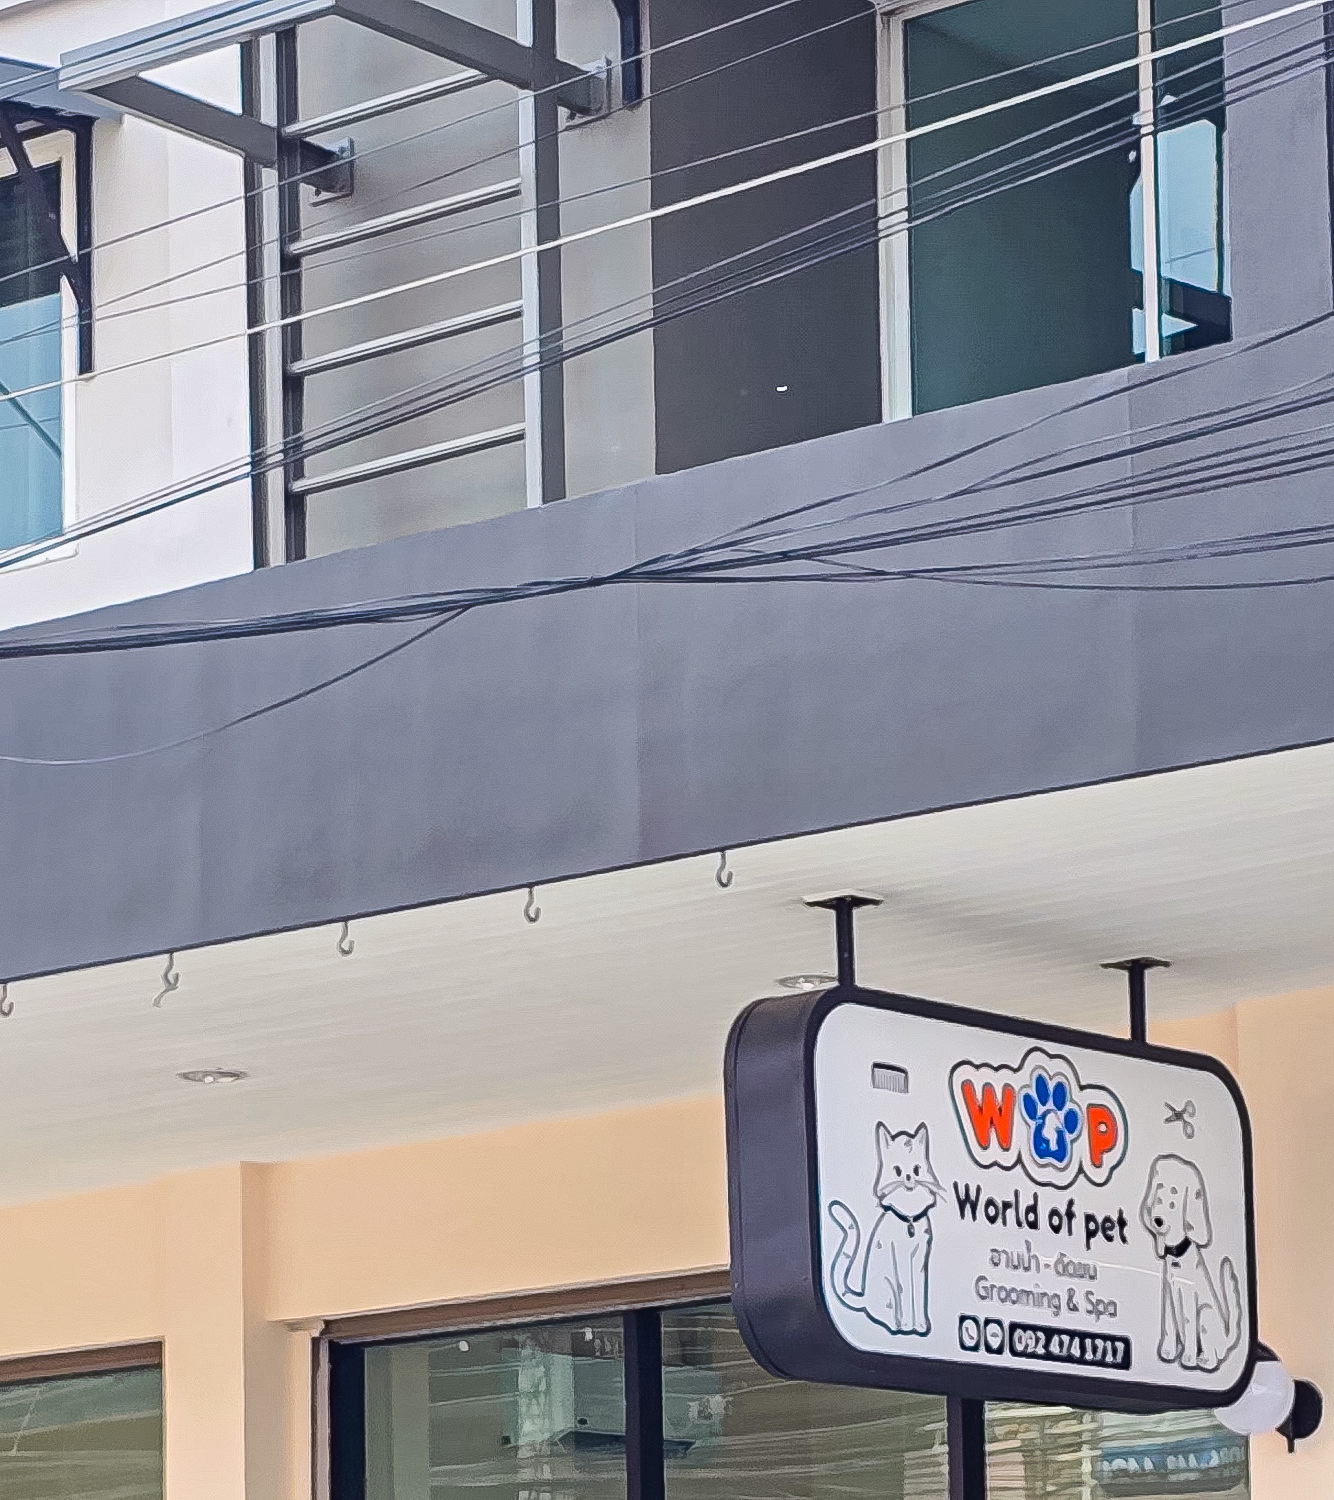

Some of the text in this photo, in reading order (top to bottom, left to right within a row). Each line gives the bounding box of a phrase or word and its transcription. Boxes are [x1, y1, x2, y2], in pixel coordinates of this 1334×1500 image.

[953, 1180, 1129, 1252] World of pet
[974, 1274, 1118, 1323] Grooming & Spa
[1013, 1327, 1126, 1363] 092 474 1717
